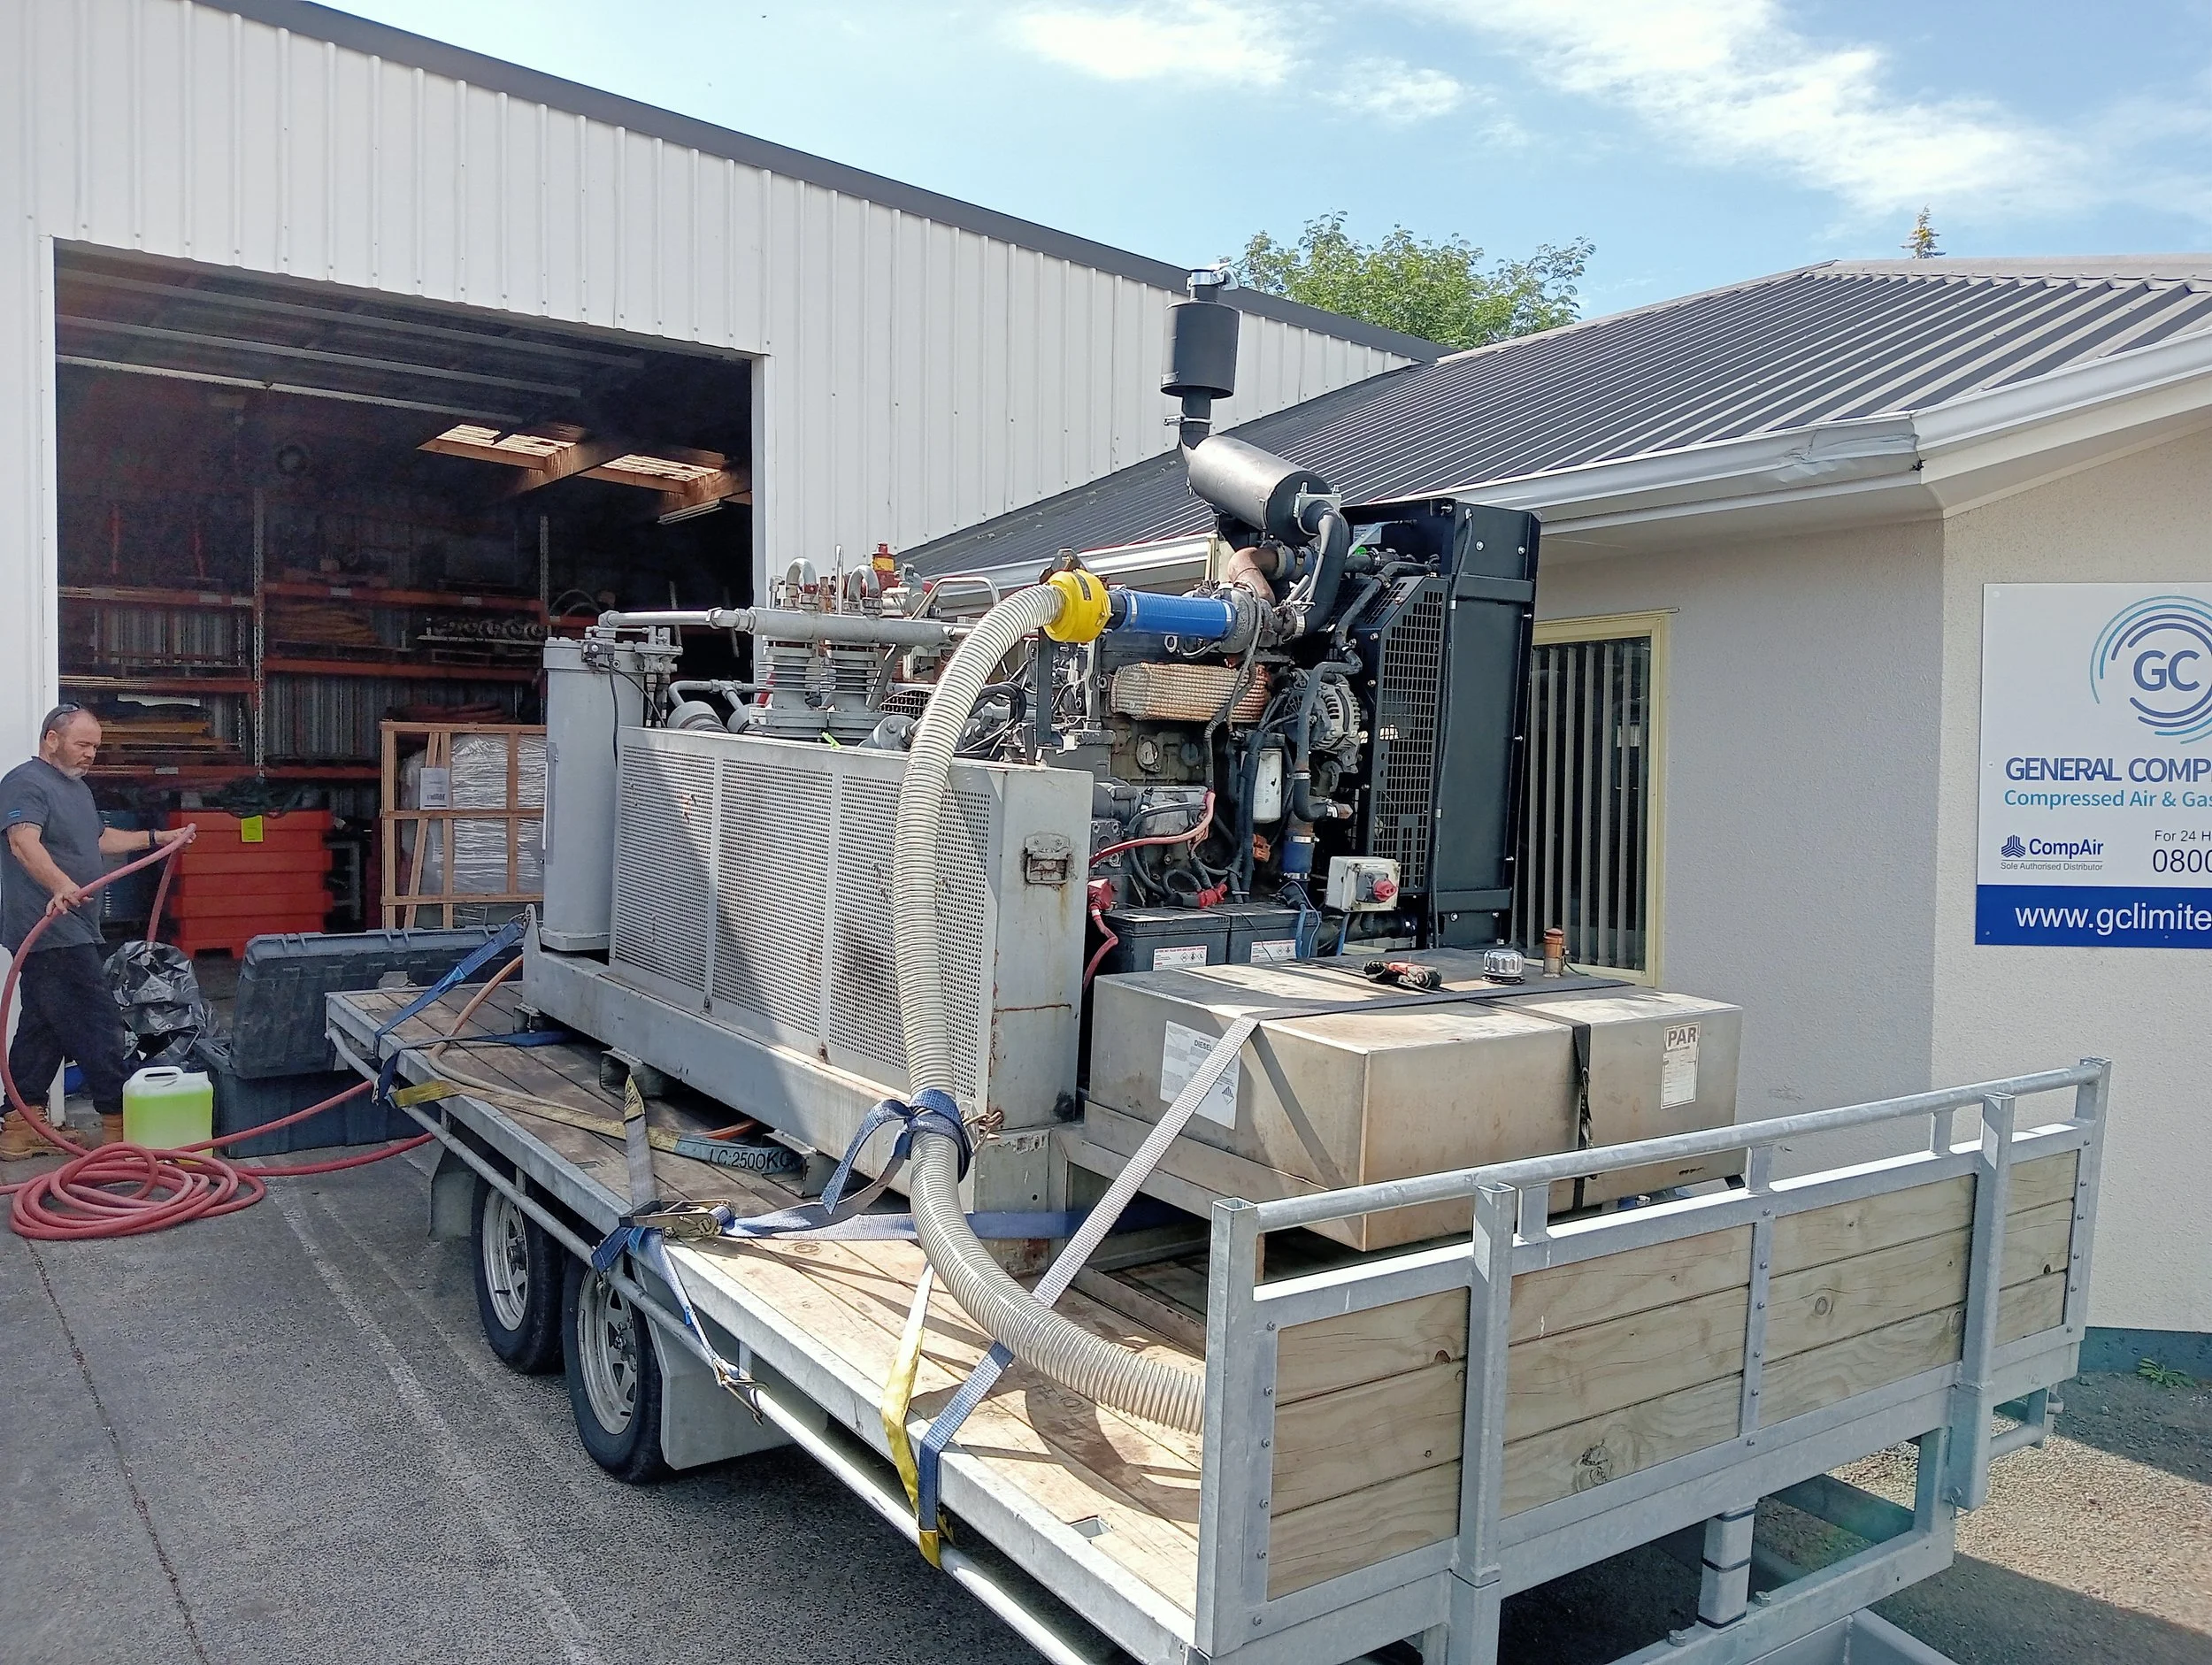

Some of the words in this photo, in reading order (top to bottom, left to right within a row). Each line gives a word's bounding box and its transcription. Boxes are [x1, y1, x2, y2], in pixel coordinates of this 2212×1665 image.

[2133, 649, 2200, 692] GC
[2005, 756, 2122, 781] GENERAL
[2128, 757, 2212, 783] COMP
[2004, 789, 2124, 810] Compressed
[2129, 790, 2157, 807] Air
[2162, 791, 2177, 807] &
[2154, 830, 2177, 842] For
[2180, 830, 2196, 842] 24
[2029, 838, 2104, 860] CompAir
[2019, 862, 2062, 871] Authorised
[2063, 863, 2103, 871] Distributor
[2015, 902, 2212, 936] www.gclimite
[1668, 1027, 1696, 1047] PAR
